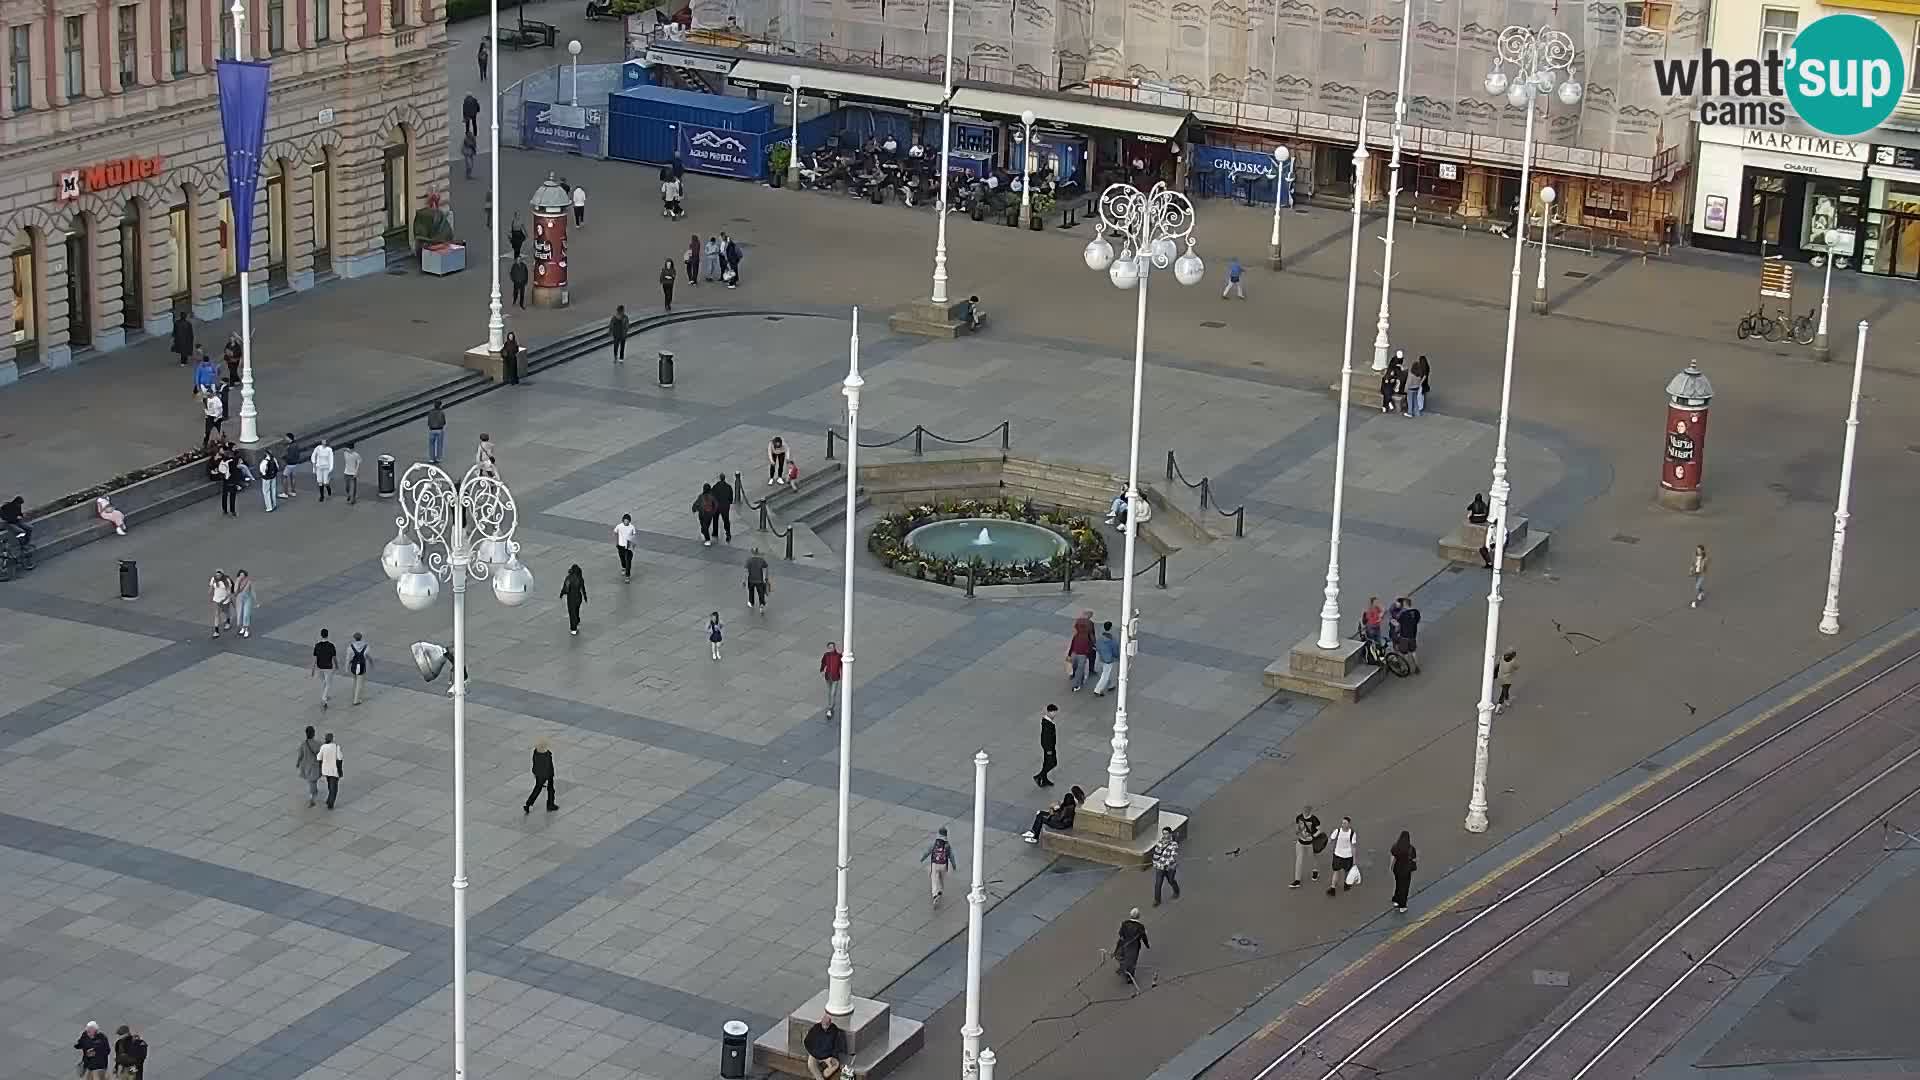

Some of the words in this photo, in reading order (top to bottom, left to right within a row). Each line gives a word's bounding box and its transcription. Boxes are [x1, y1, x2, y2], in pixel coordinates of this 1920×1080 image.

[1748, 131, 1858, 158] MARTIMEX
[63, 177, 76, 192] M
[86, 155, 164, 191] Müller
[1214, 159, 1272, 175] GRADSKA
